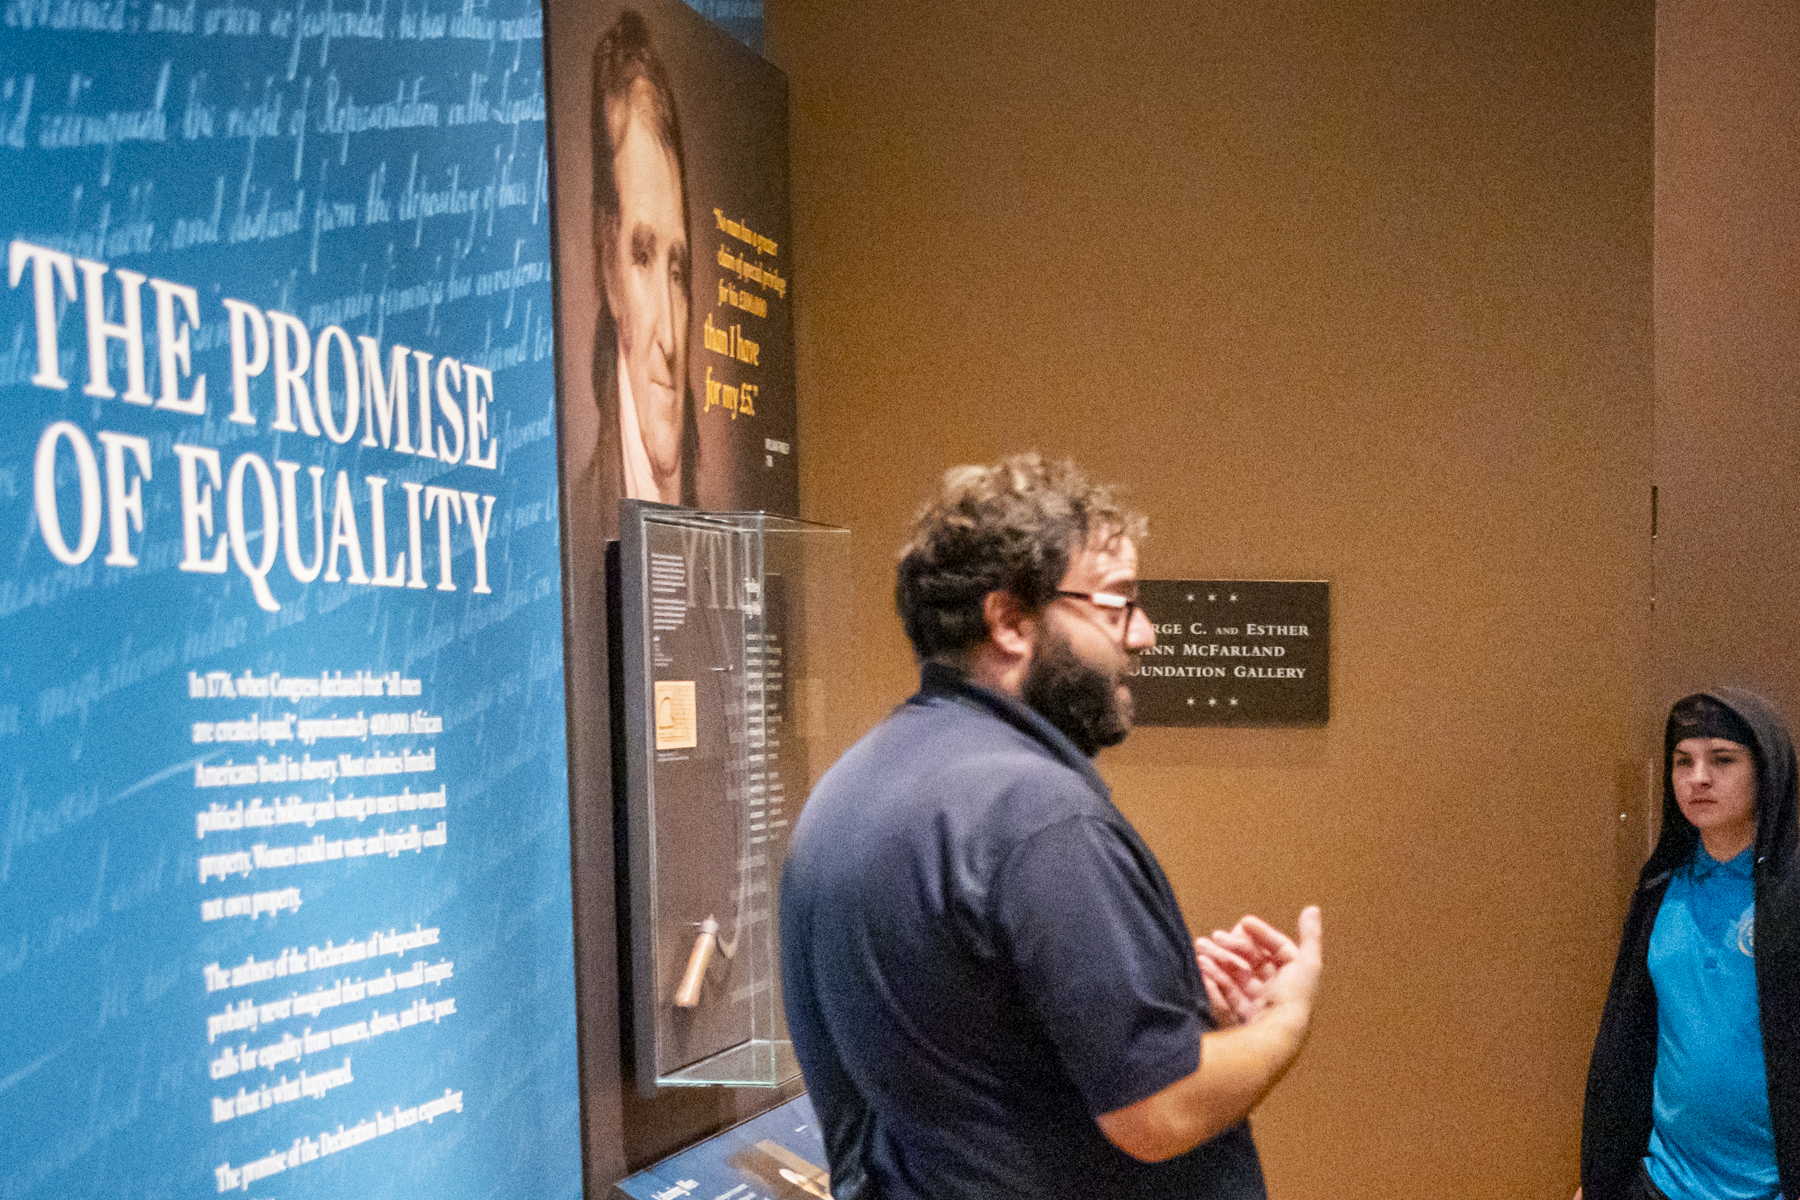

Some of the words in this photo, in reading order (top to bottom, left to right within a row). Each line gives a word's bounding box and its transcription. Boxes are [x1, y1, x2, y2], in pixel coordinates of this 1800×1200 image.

[10, 241, 206, 415] THE
[225, 299, 498, 470] PROMISE
[704, 311, 729, 357] than
[730, 325, 736, 358] I
[737, 324, 759, 366] have
[704, 364, 722, 415] for
[723, 382, 740, 419] my
[35, 421, 152, 567] OF
[175, 443, 498, 612] EQUALITY
[1190, 622, 1207, 635] C.
[1246, 623, 1309, 636] ESTHER
[1233, 665, 1307, 679] GALLERY
